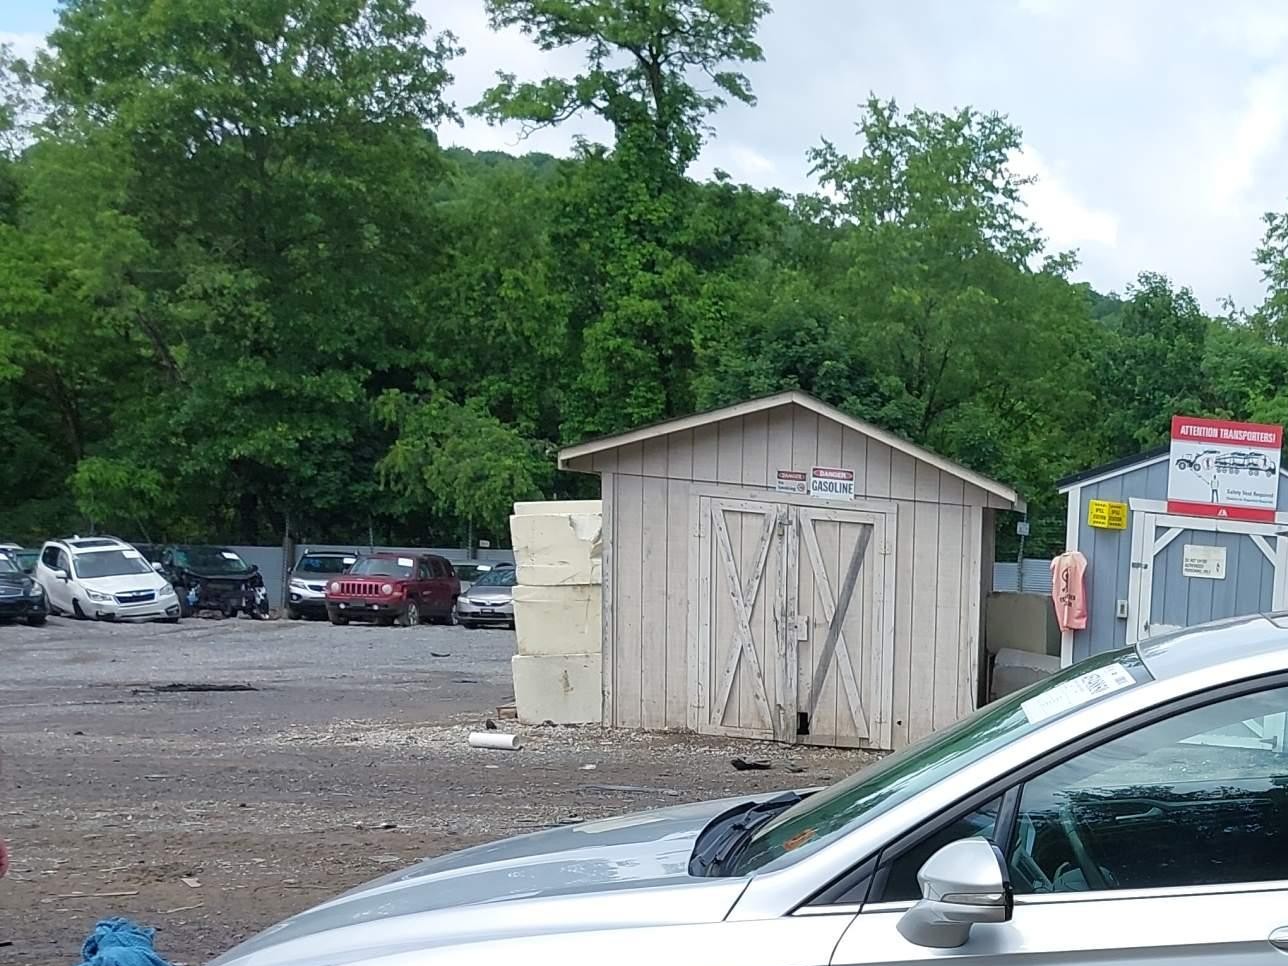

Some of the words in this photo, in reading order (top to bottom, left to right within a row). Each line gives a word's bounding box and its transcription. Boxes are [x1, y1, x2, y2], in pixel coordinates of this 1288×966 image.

[1180, 425, 1218, 438] ATTENTION
[1220, 428, 1276, 443] TRANSPORTERS!
[820, 470, 847, 479] DANGER
[812, 480, 854, 495] GASOLINE
